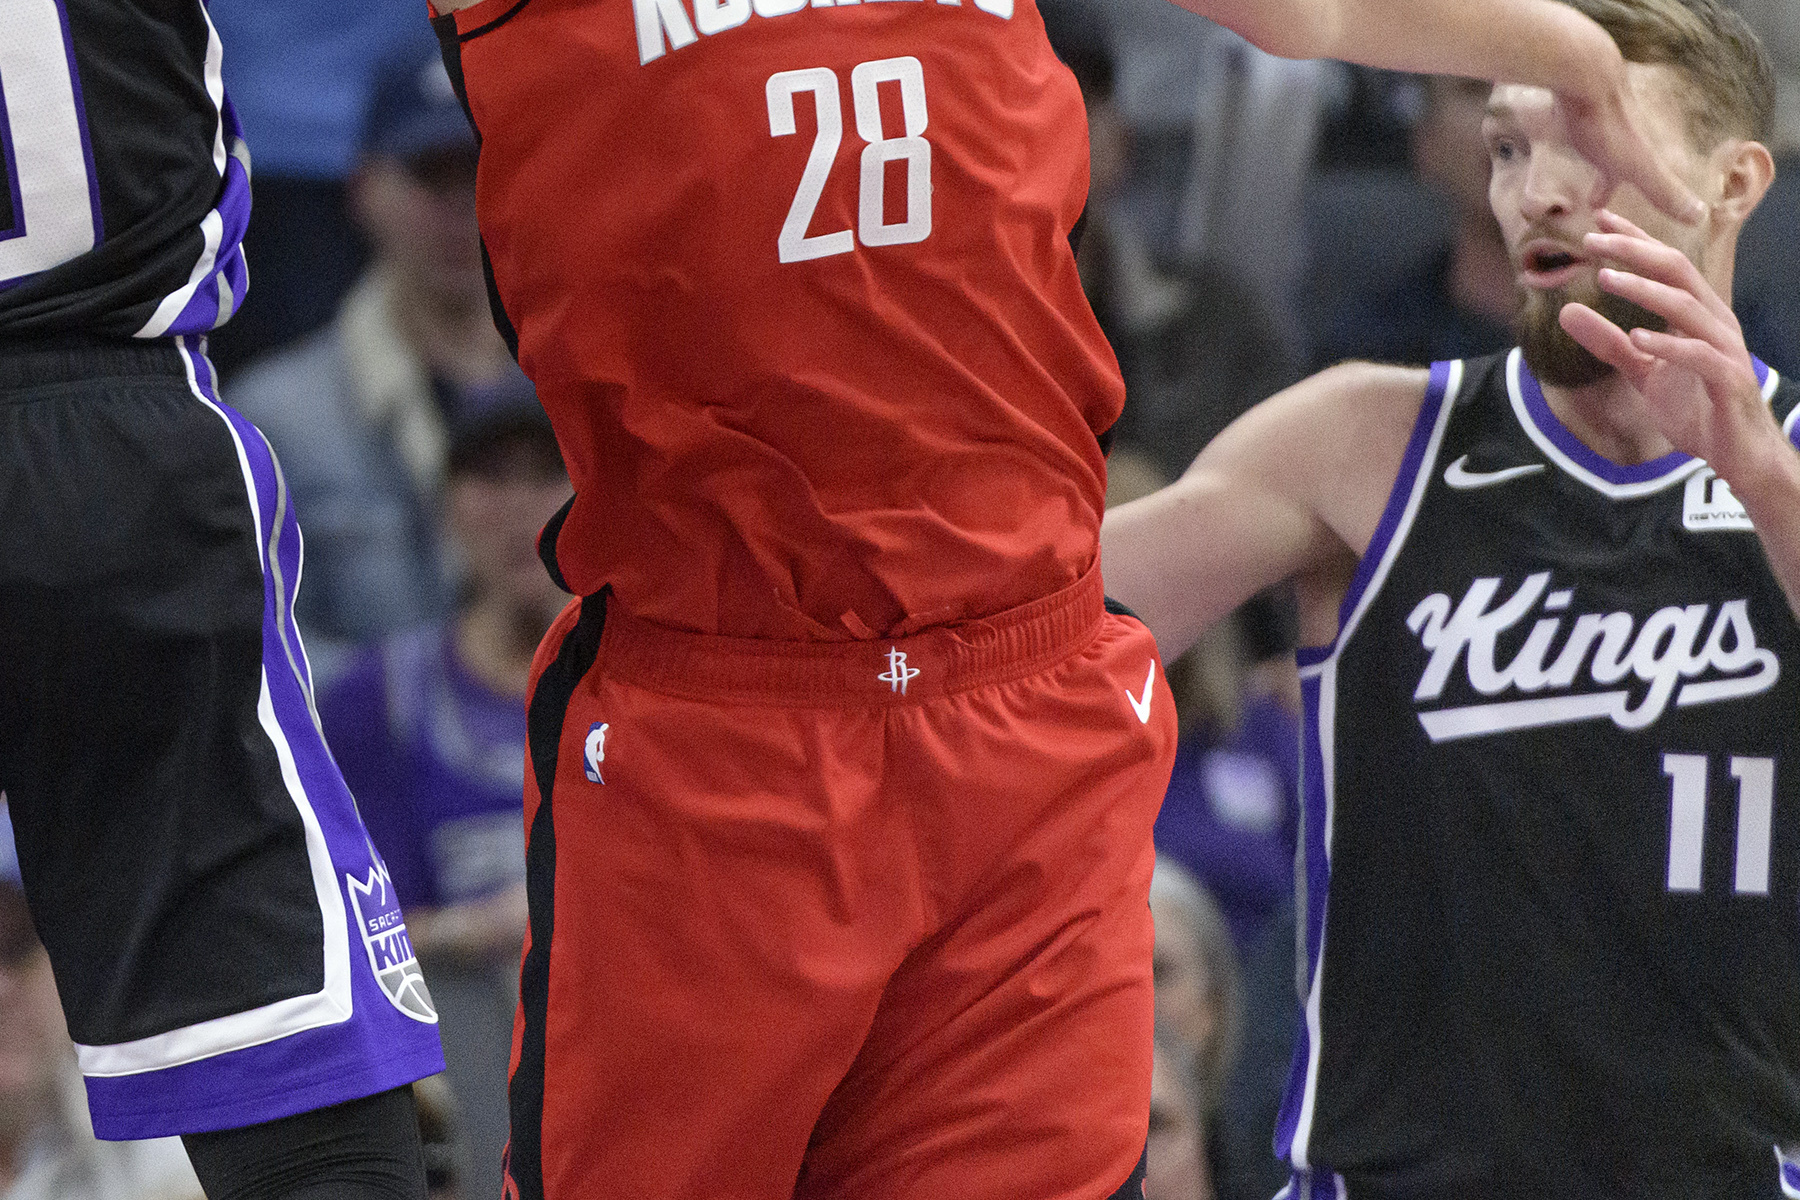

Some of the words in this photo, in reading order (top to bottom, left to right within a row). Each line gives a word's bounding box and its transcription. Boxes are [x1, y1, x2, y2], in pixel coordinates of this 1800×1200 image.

[765, 56, 934, 264] 28
[1406, 571, 1780, 743] Kings
[1662, 752, 1775, 894] 11
